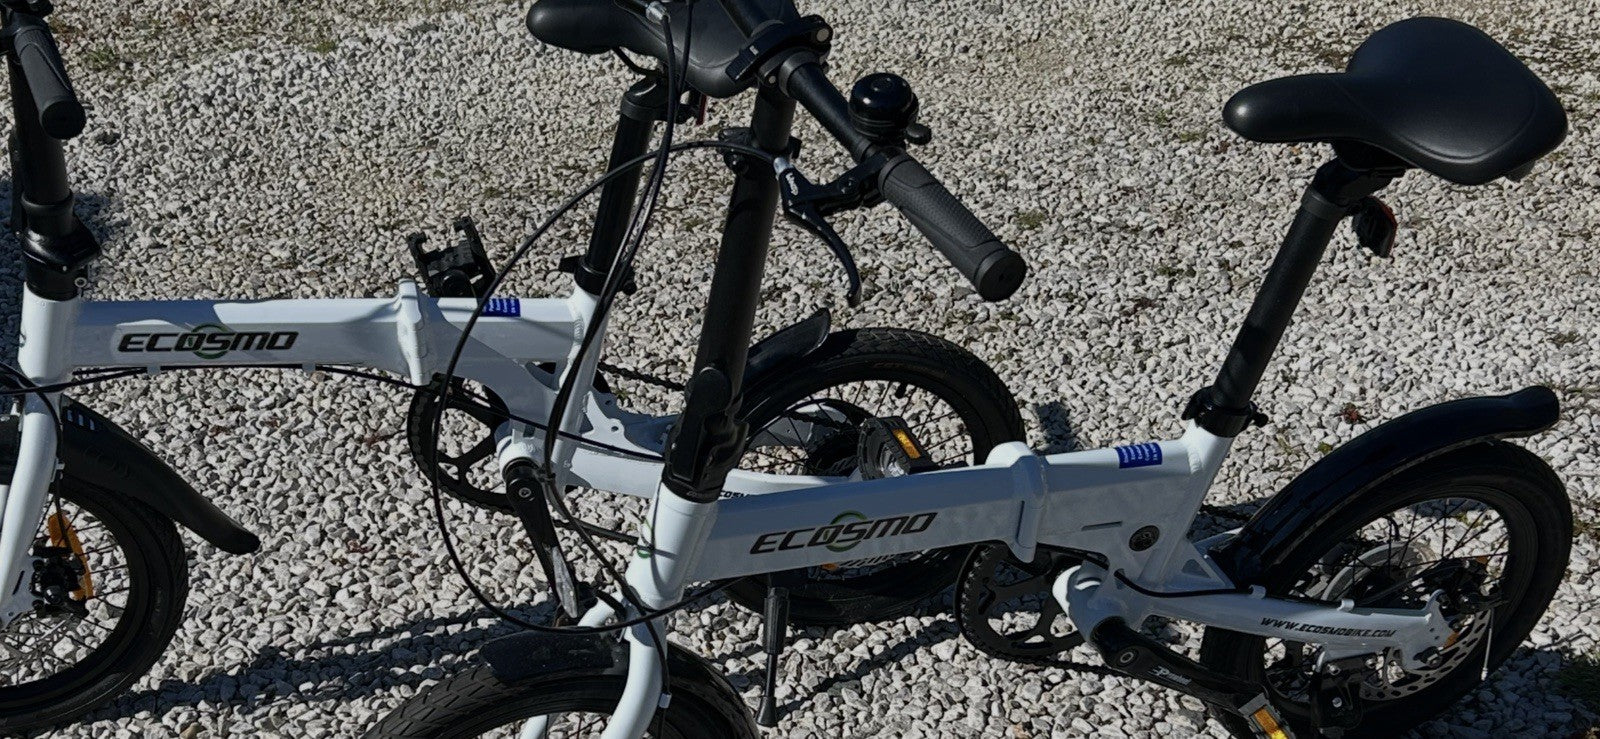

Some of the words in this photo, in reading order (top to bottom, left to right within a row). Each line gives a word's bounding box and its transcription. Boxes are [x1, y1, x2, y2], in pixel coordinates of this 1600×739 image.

[117, 331, 299, 352] ECOSMO
[750, 512, 938, 554] ECOSMO
[1260, 617, 1397, 637] WWW.ECOSMOBIKE.COM
